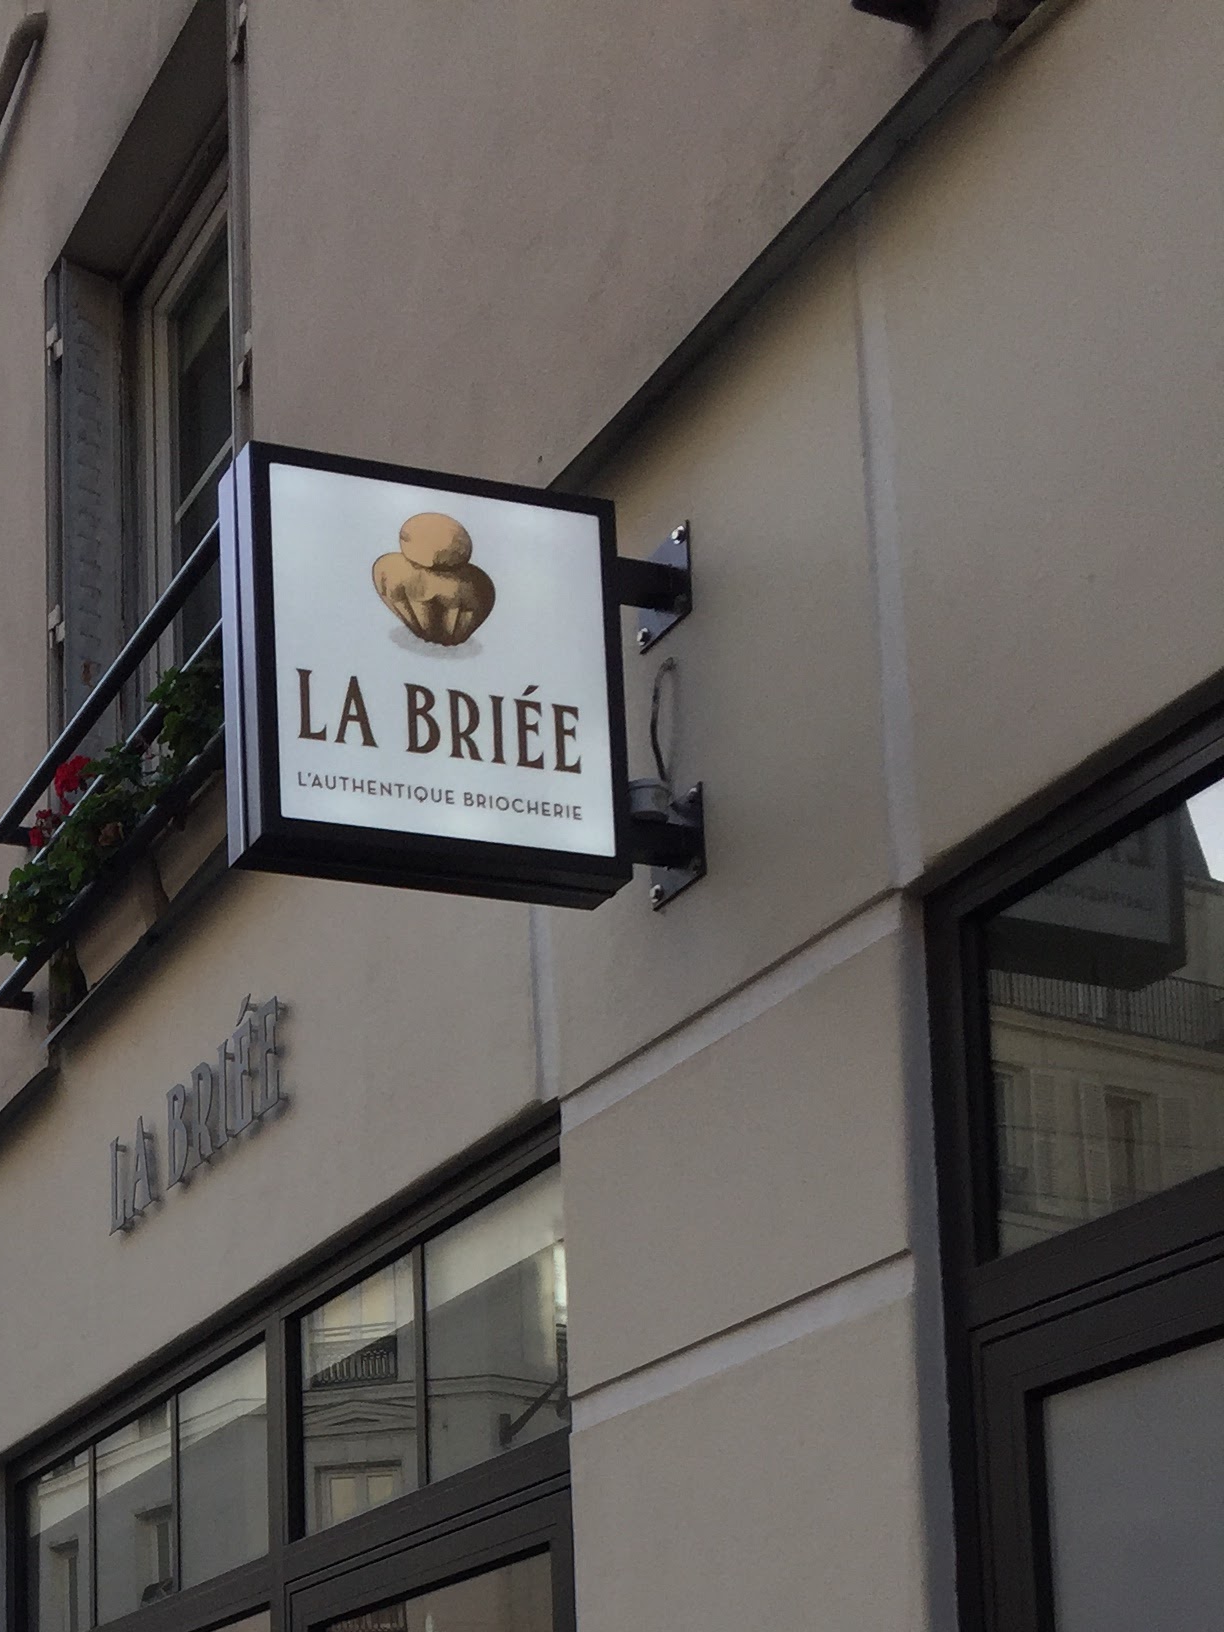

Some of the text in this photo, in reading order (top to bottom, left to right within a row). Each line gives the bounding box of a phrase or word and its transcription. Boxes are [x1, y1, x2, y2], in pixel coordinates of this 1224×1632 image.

[295, 668, 582, 775] LA BRIÉE
[297, 771, 583, 822] L'AUTHENTIQUE BRIOCHERIE
[108, 993, 288, 1237] LA BRIÉE
